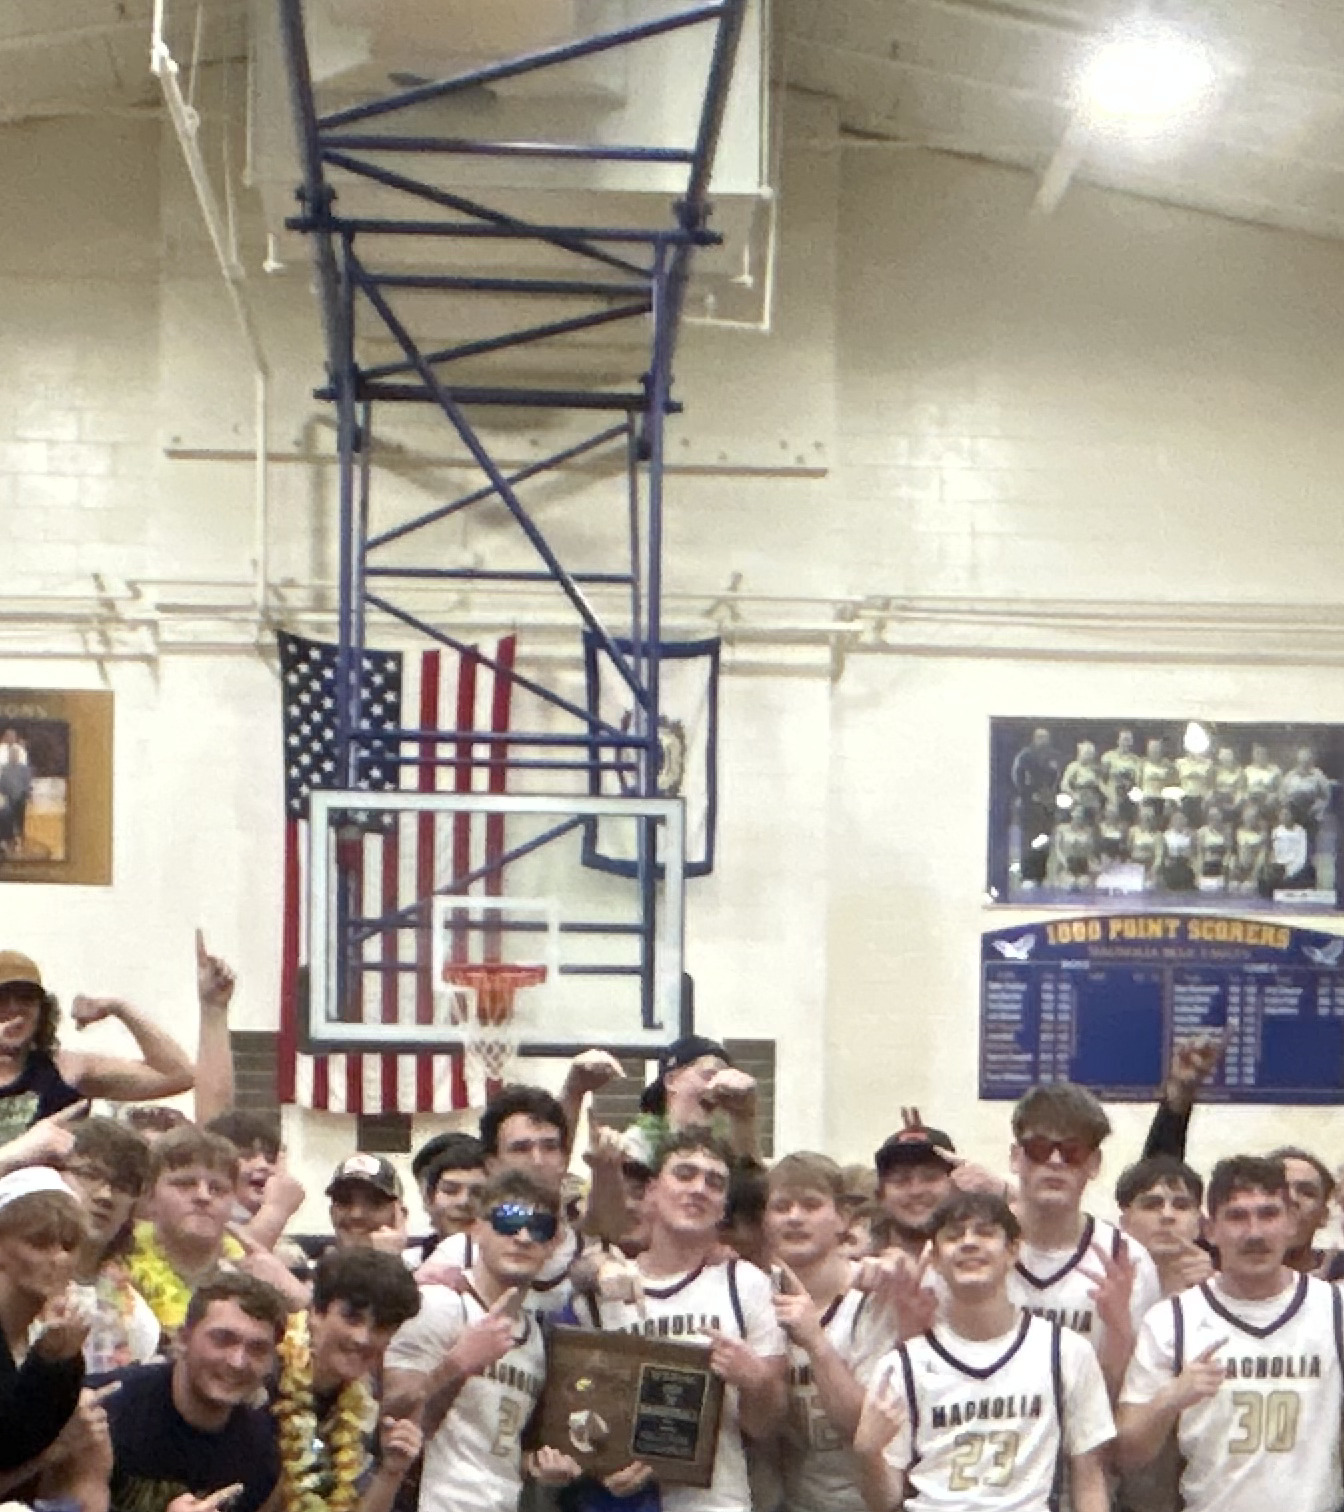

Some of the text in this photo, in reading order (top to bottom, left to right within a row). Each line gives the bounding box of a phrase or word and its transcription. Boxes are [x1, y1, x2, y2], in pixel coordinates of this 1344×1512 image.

[1108, 917, 1180, 940] POINT
[1187, 918, 1292, 950] SCORERS
[618, 1304, 720, 1336] AGNOLIA
[1225, 1355, 1322, 1380] AGNOLIA
[932, 1394, 1043, 1429] MAGNOLIA
[1228, 1390, 1299, 1454] 30
[948, 1430, 1021, 1492] 23
